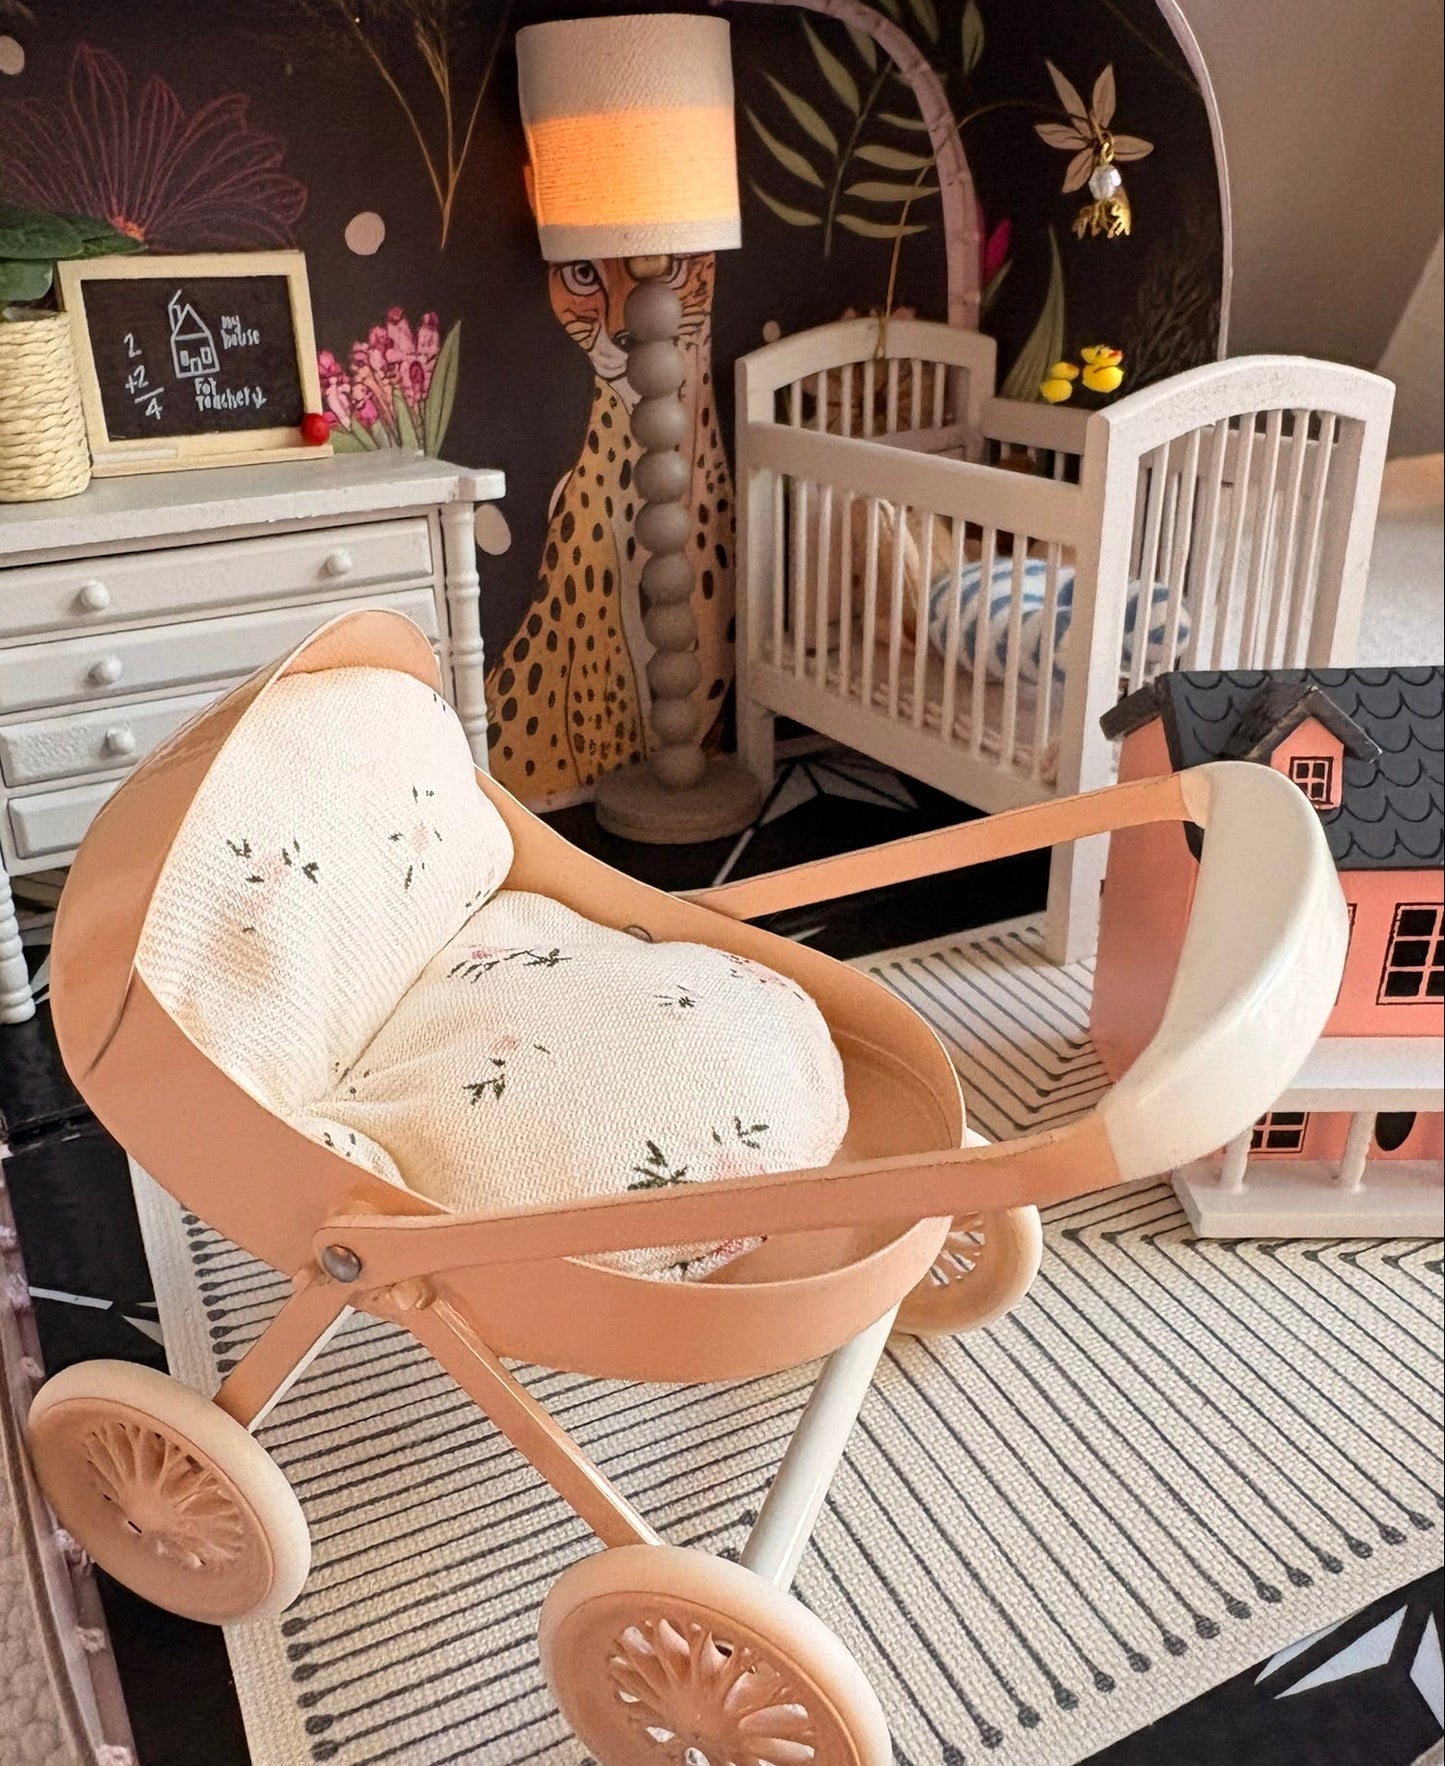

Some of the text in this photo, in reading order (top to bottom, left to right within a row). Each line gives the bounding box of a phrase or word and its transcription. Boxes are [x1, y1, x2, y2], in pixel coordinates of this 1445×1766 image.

[221, 315, 241, 334] my
[124, 332, 142, 358] 2
[221, 329, 260, 350] house
[145, 397, 163, 420] 4
